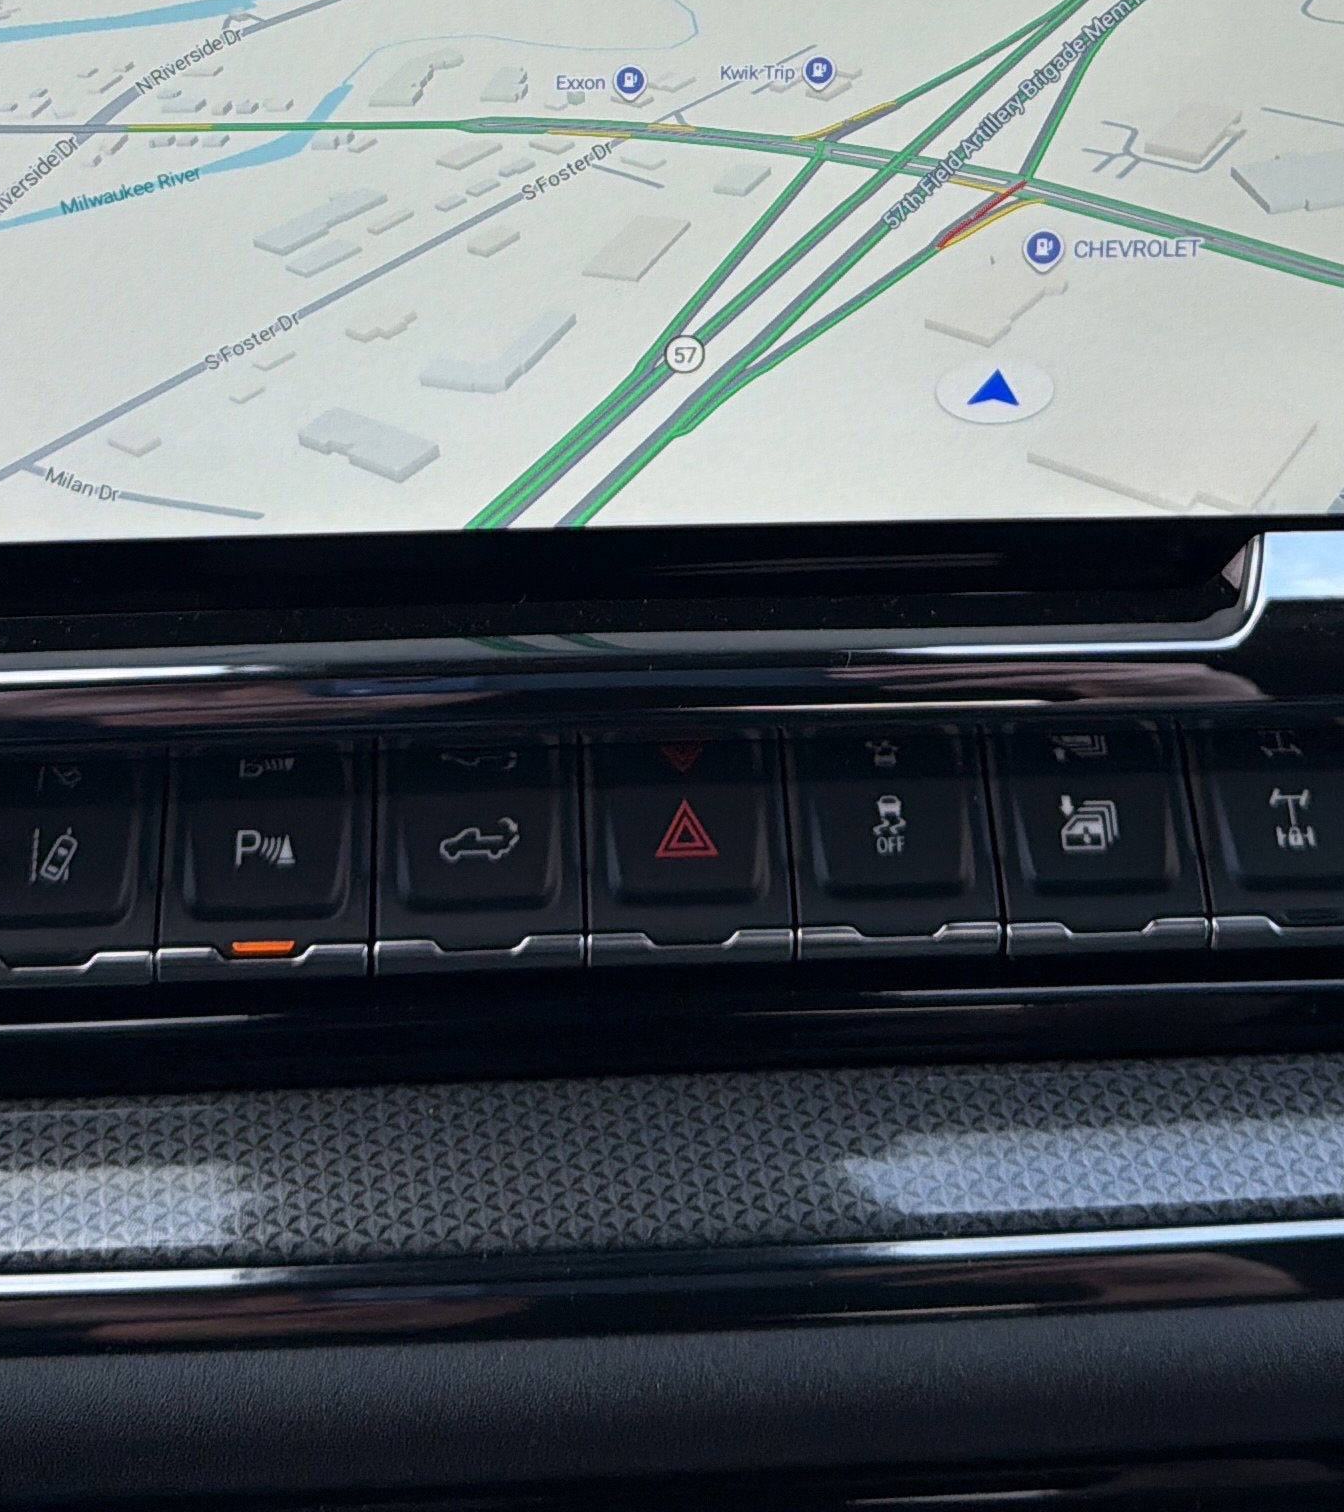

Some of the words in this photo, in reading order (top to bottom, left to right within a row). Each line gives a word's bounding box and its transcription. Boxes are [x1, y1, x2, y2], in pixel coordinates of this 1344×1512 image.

[136, 76, 152, 95] N
[150, 37, 224, 86] Riverside
[222, 26, 243, 45] Dr
[720, 65, 759, 80] Kwik
[764, 65, 795, 82] Trip
[556, 75, 606, 91] Exxon
[882, 194, 924, 229] 57th
[919, 153, 964, 196] Field
[959, 93, 1025, 158] Artillery
[1017, 36, 1088, 100] Brigade
[57, 135, 80, 160] Dr
[522, 183, 538, 202] S
[536, 153, 592, 192] Foster
[591, 141, 613, 163] Dr
[60, 182, 155, 215] Milwaukee
[156, 167, 201, 190] River
[1073, 240, 1201, 258] CHEVROLET
[205, 352, 222, 371] S
[219, 324, 278, 365] Foster
[276, 312, 301, 335] Dr
[674, 346, 697, 364] 57
[46, 467, 96, 497] Milan
[99, 483, 120, 501] Dr
[876, 836, 905, 854] OFF
